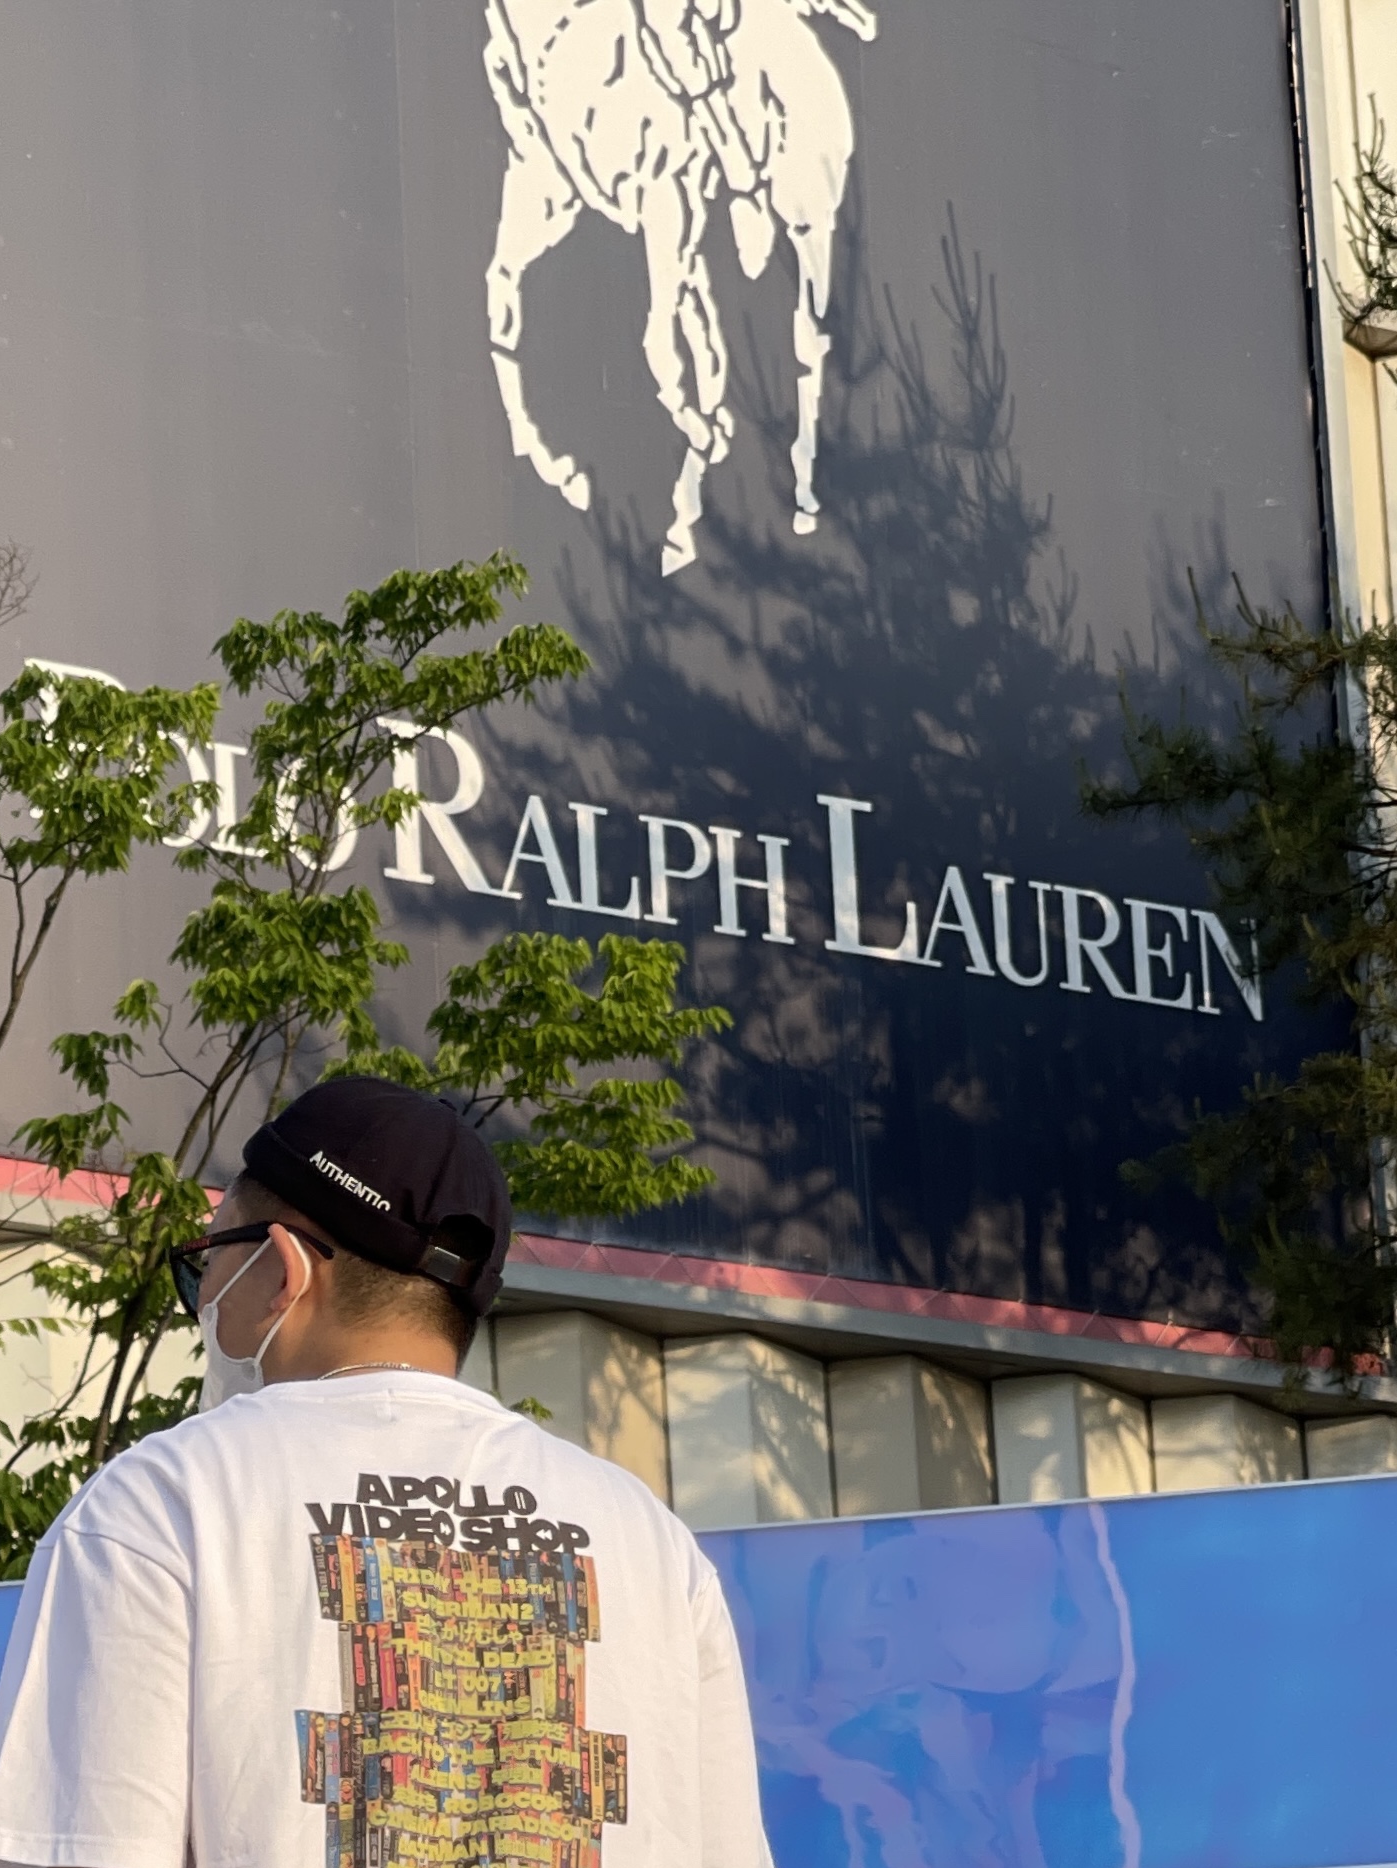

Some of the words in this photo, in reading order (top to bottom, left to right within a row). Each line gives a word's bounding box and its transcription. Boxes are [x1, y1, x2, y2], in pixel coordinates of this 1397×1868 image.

[376, 717, 795, 945] RALPH
[816, 794, 1264, 1022] LAUREN
[309, 1150, 392, 1212] AUTHENTIC
[356, 1473, 537, 1517] APOLLO
[304, 1502, 455, 1548] VIDEO
[459, 1517, 590, 1555] SHOP
